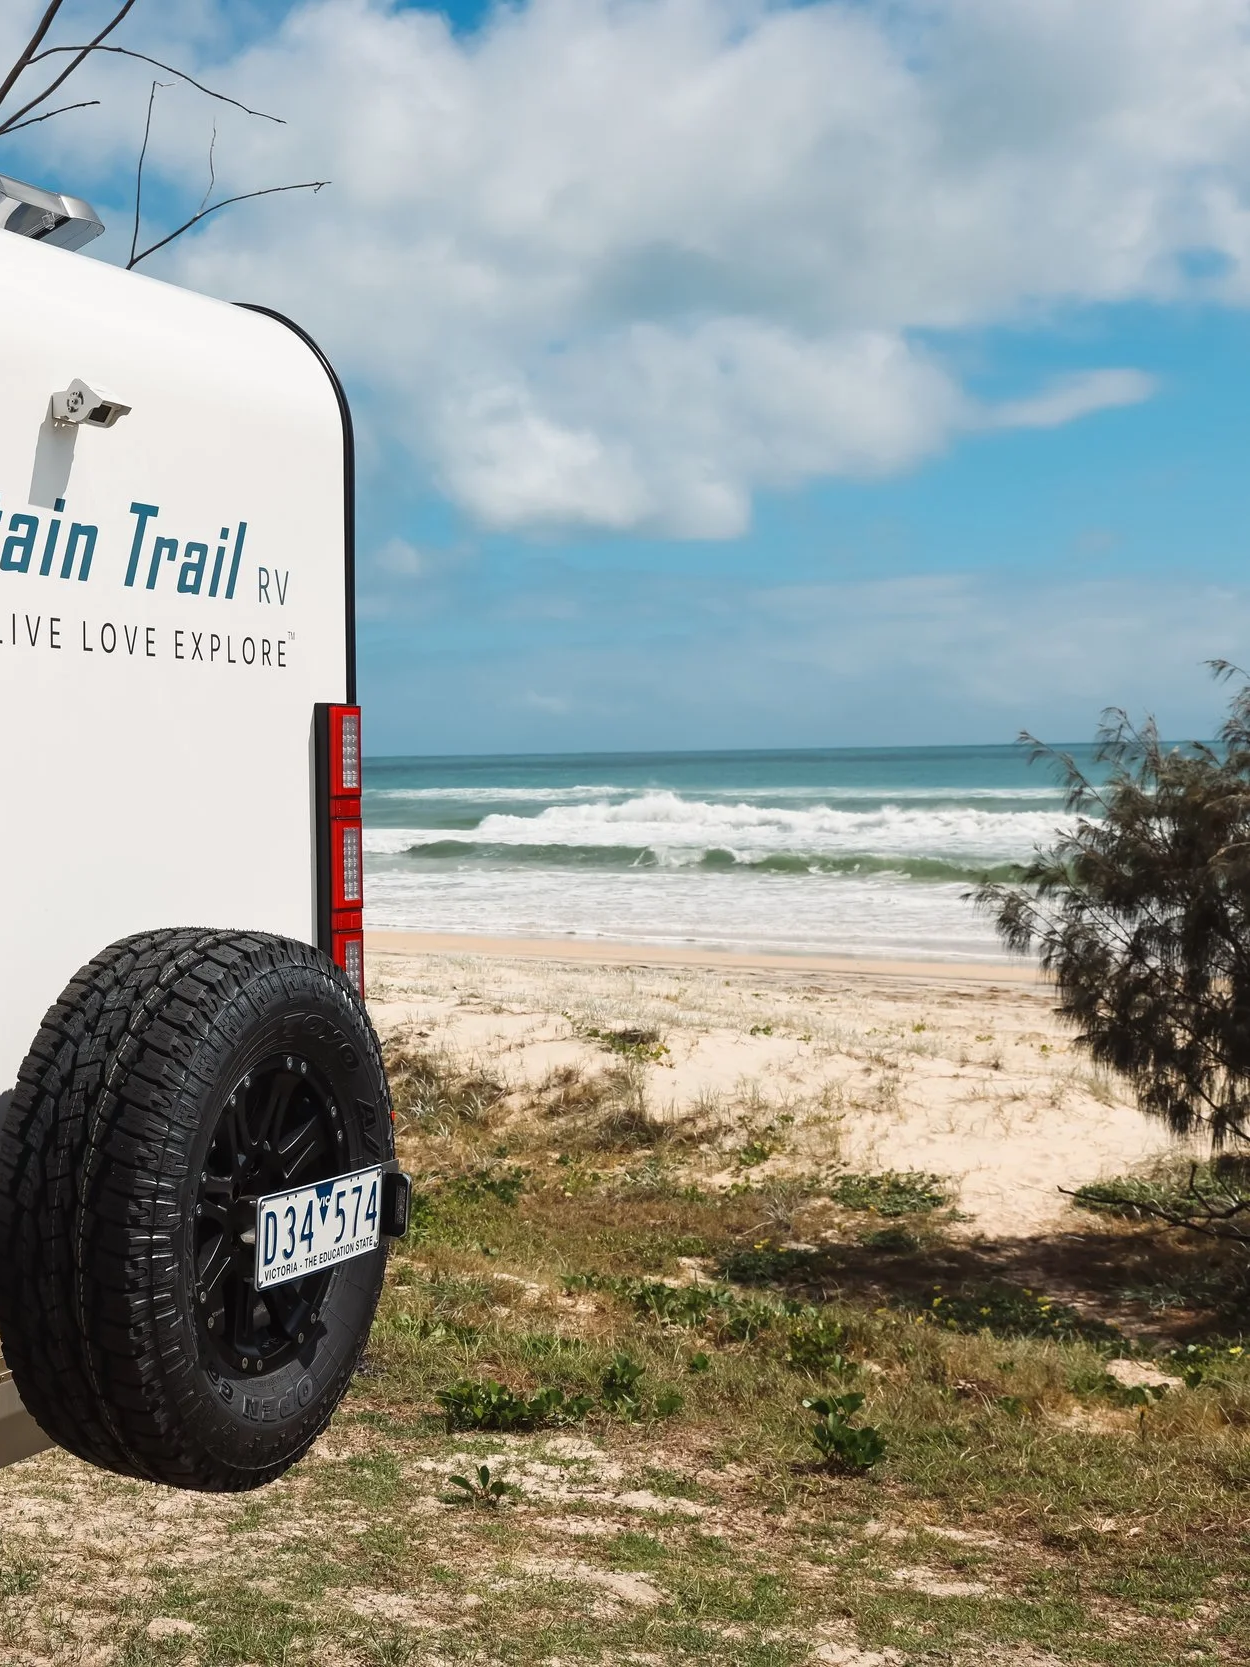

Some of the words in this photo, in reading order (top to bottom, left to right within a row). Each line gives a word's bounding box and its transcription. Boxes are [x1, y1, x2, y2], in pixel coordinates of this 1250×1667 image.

[123, 501, 248, 600] Trail
[258, 566, 289, 606] RV
[82, 620, 156, 657] LOVE
[174, 630, 287, 668] EXPLORE
[263, 1199, 314, 1268] D34
[334, 1180, 377, 1245] 574
[318, 1195, 331, 1208] VIC
[264, 1262, 298, 1282] VICTORIA
[304, 1254, 318, 1270] THE
[319, 1242, 354, 1263] EDUCATION
[355, 1235, 373, 1252] STATE
